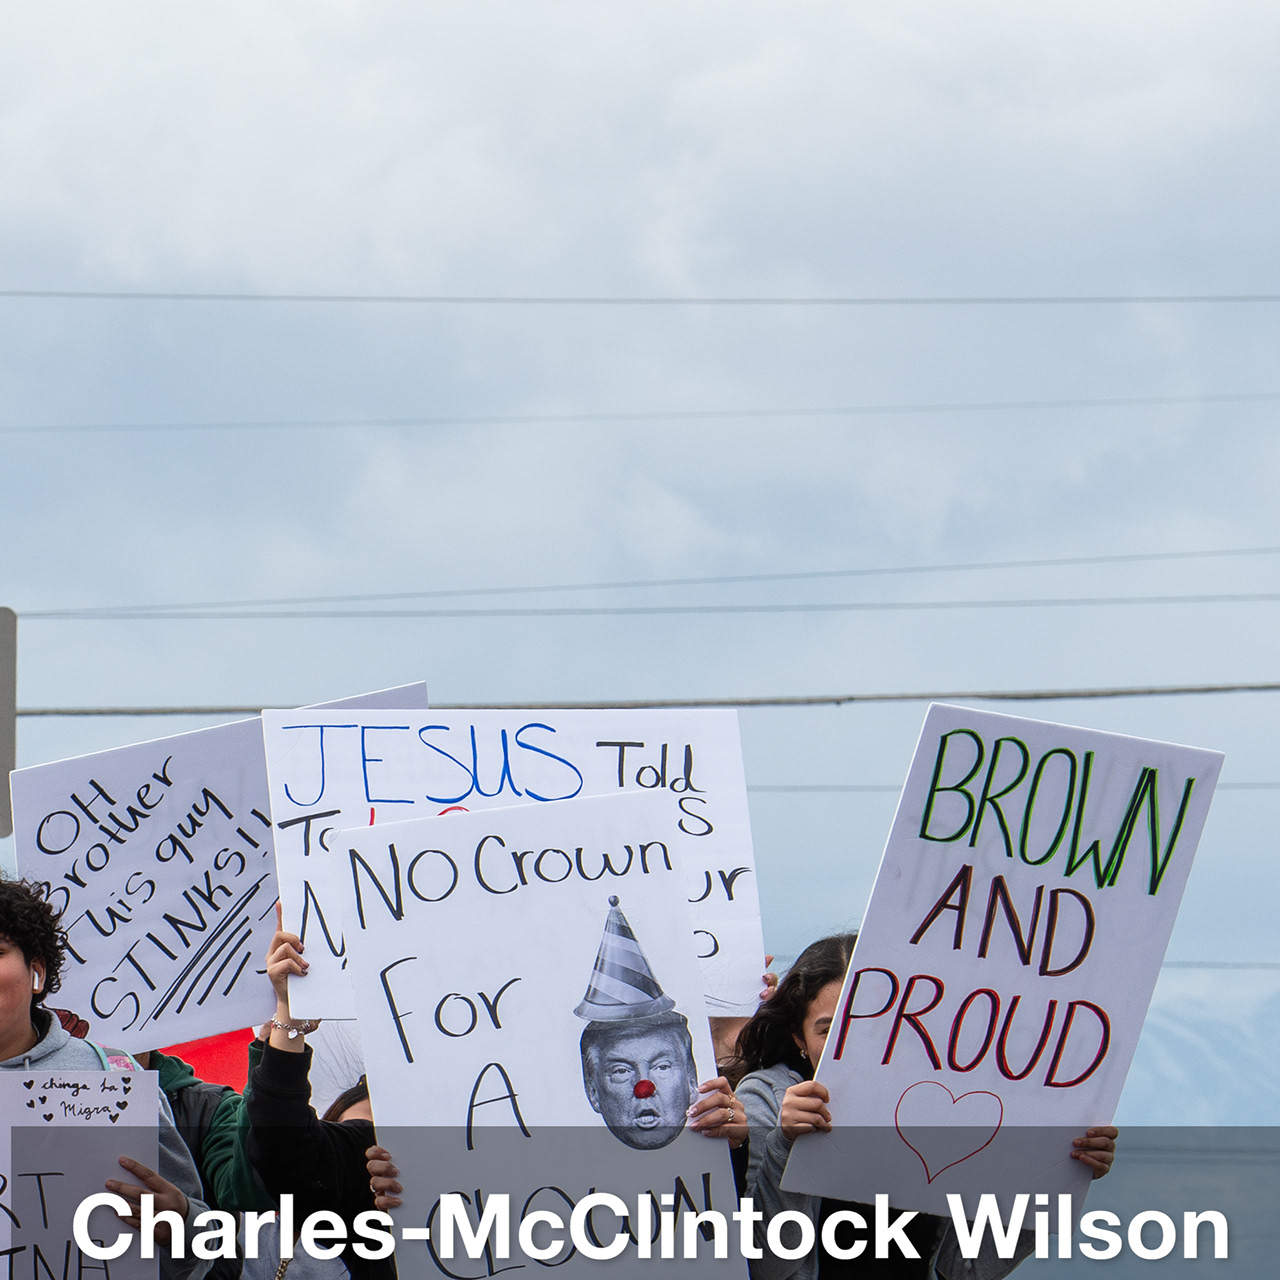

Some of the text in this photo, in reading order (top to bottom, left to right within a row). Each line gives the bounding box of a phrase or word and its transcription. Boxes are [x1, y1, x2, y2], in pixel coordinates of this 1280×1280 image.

[282, 722, 707, 806] JESUS Told
[36, 778, 117, 855] OH
[919, 728, 1196, 897] BROWN
[474, 833, 673, 896] Crown
[910, 864, 1096, 977] AND
[381, 955, 523, 1064] For
[833, 967, 1112, 1089] PROUD
[60, 1100, 111, 1121] Migra
[466, 1062, 532, 1152] A
